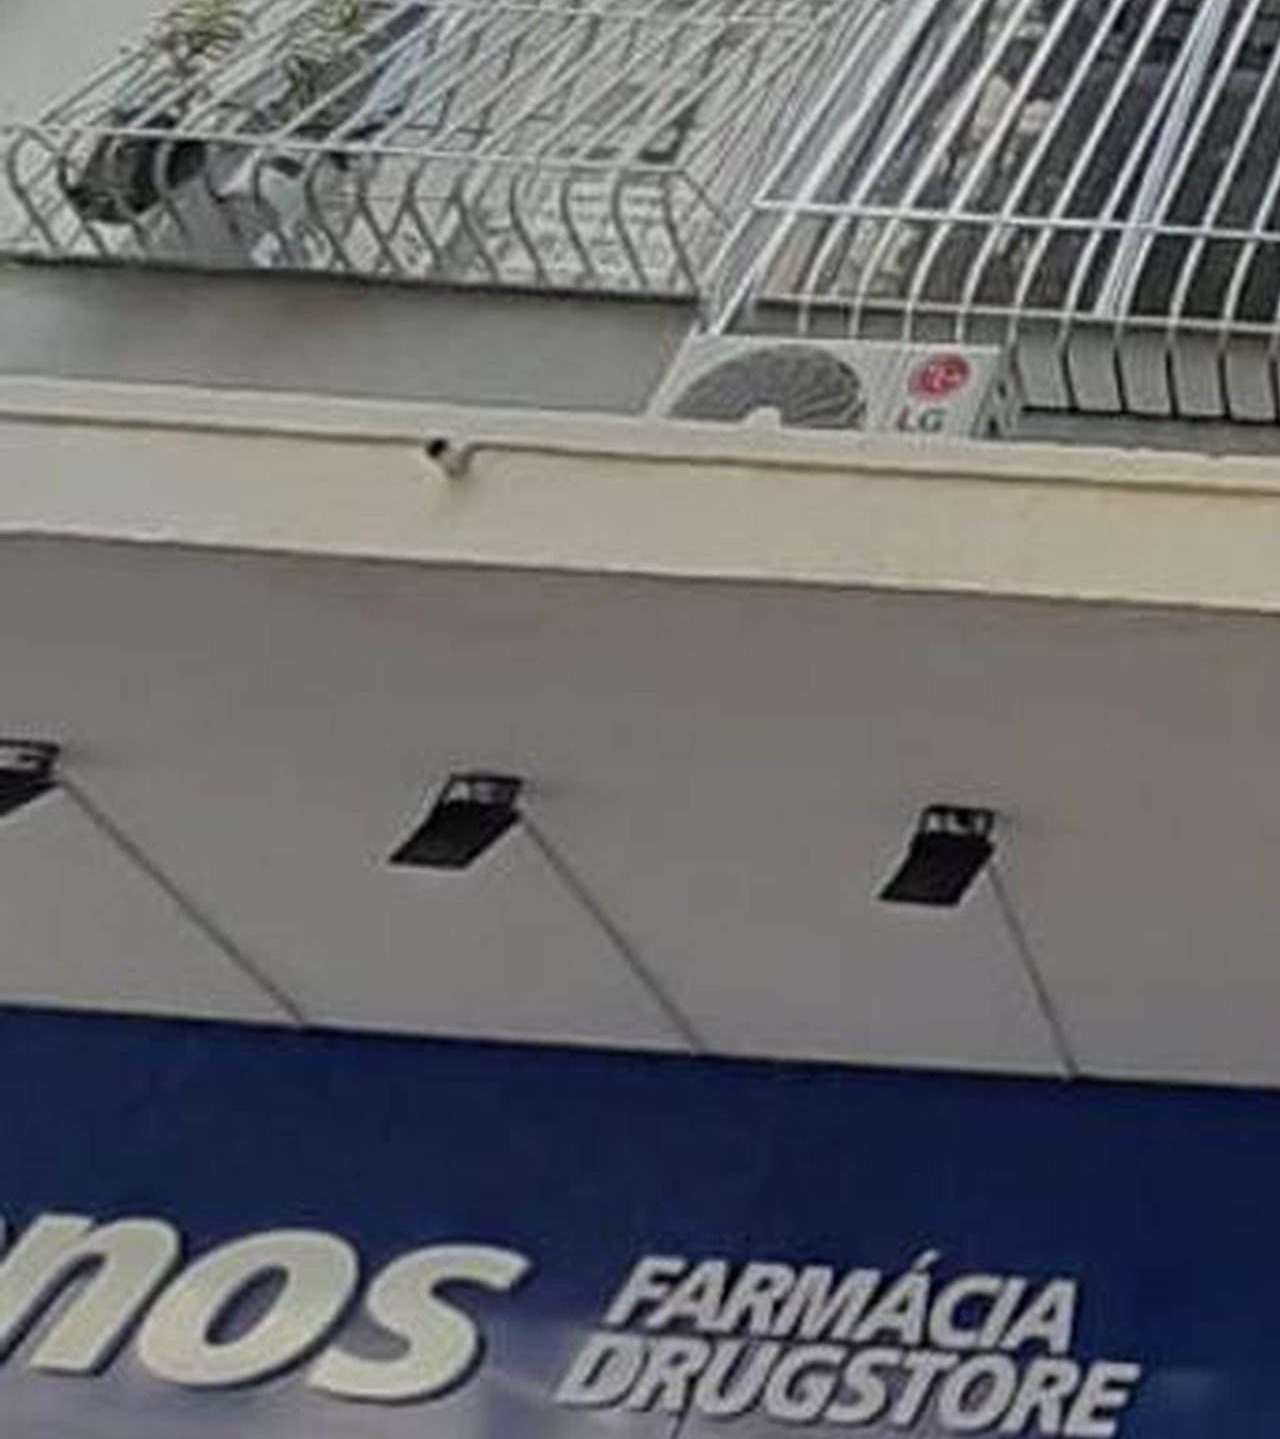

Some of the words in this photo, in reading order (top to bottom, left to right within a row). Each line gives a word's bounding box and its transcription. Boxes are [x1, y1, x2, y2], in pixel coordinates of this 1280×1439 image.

[895, 405, 949, 433] LG
[0, 1212, 532, 1401] nos
[603, 1249, 1077, 1354] FARMÁCIA
[553, 1333, 1141, 1439] DRUGSTORE
